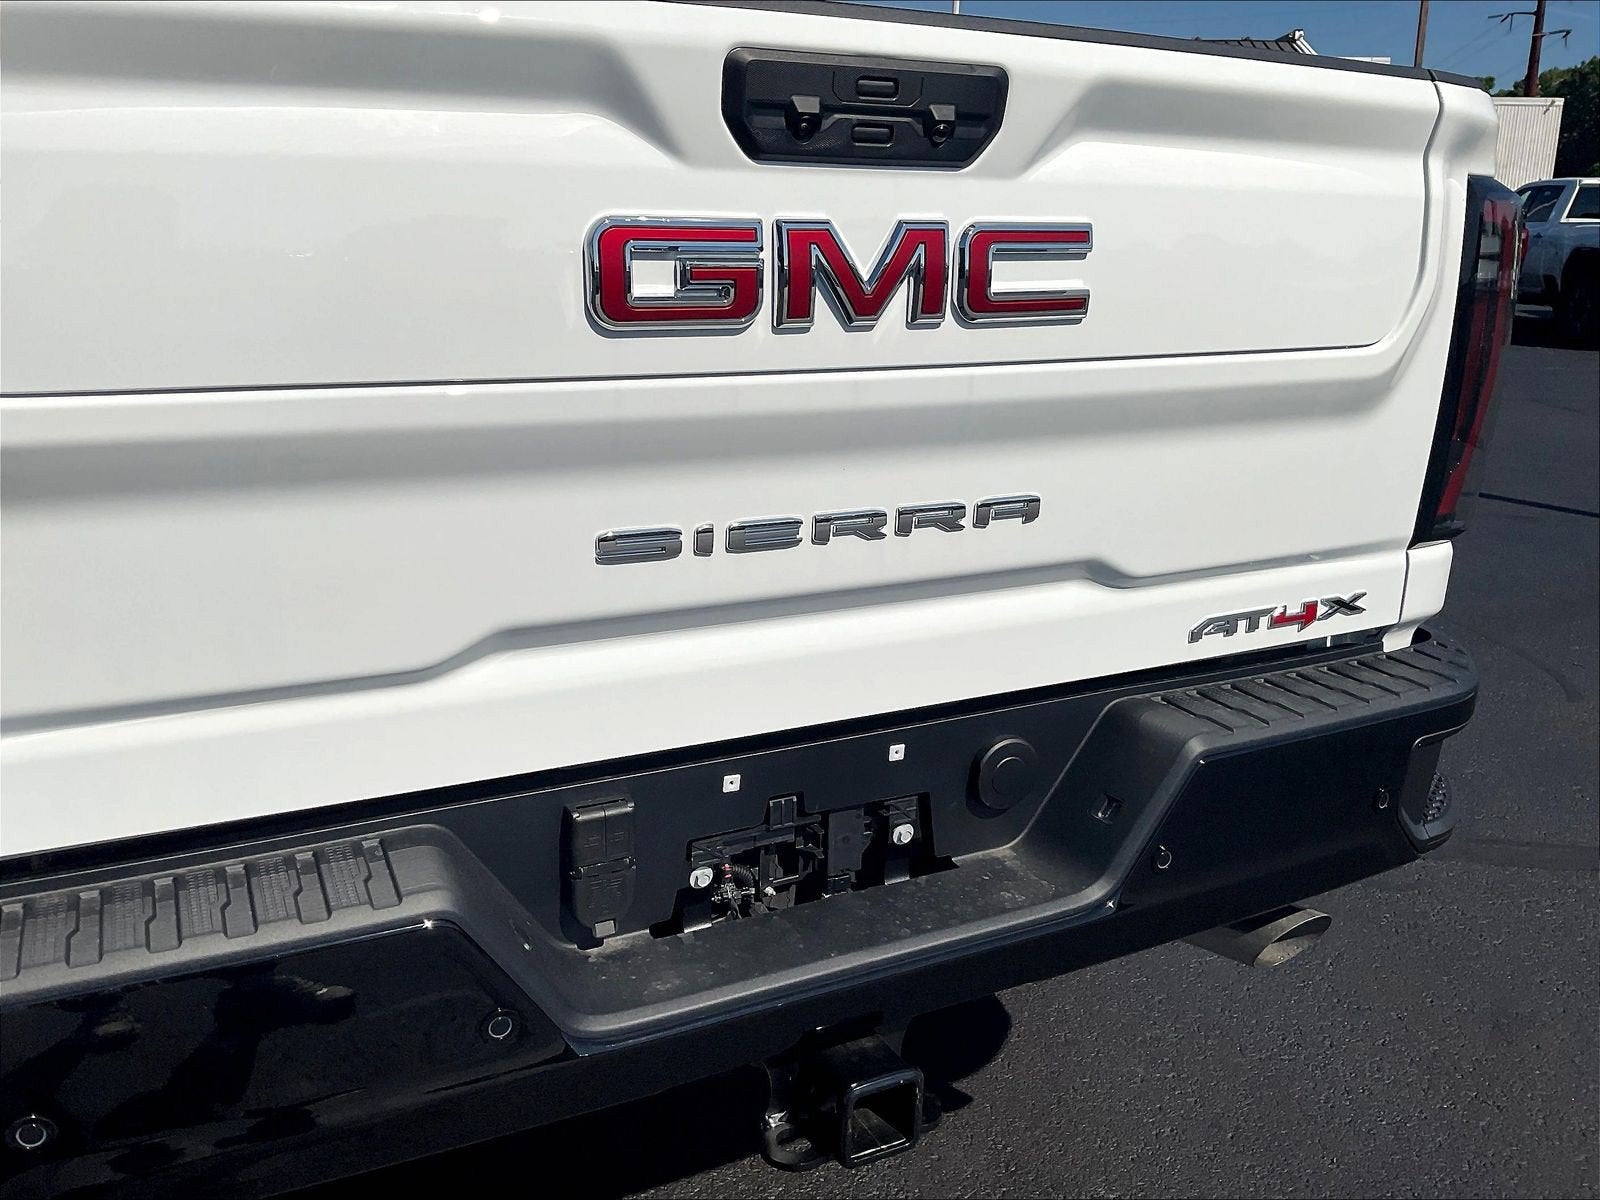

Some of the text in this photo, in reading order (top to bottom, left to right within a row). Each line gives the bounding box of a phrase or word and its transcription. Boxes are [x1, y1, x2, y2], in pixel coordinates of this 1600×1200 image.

[584, 216, 1093, 336] GMC
[595, 494, 1041, 565] SIERRA
[1188, 592, 1367, 643] AT4X
